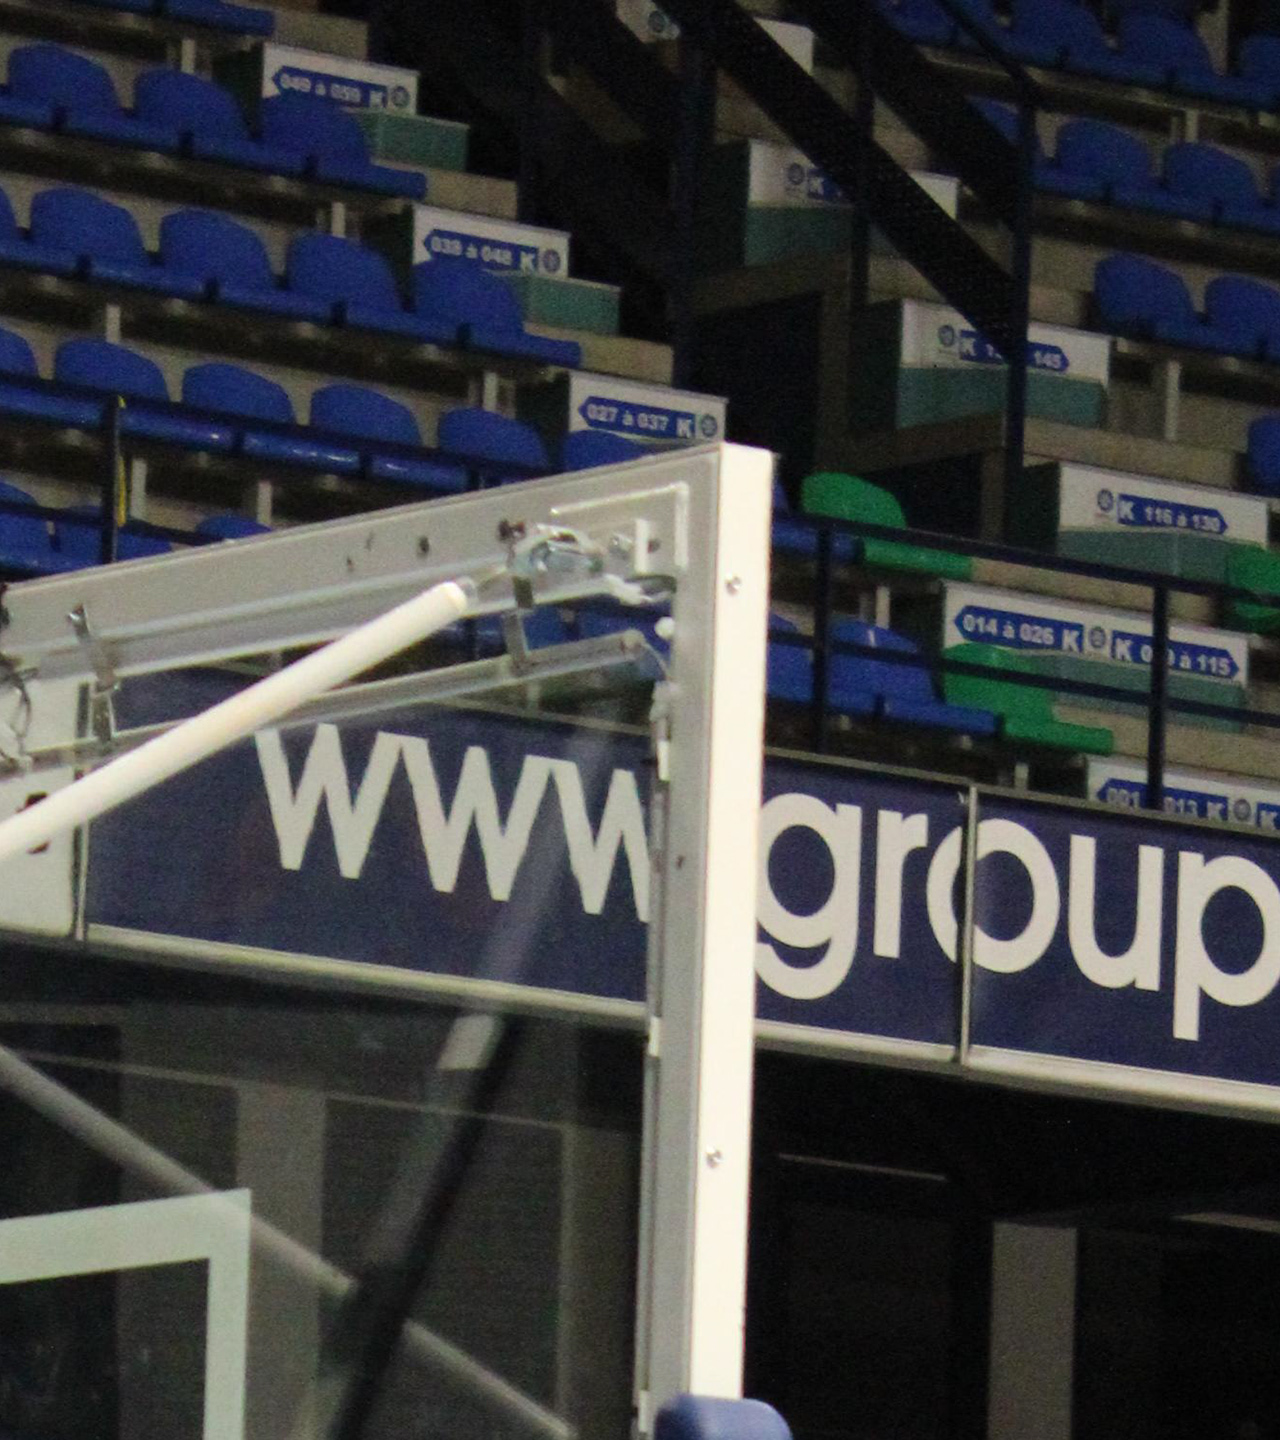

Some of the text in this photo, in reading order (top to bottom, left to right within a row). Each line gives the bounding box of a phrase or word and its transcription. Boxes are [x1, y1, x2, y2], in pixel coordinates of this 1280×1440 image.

[586, 404, 617, 423] 027
[637, 413, 668, 432] 037
[677, 418, 693, 438] K
[963, 614, 997, 633] 014
[1020, 624, 1054, 646] 026
[1062, 629, 1081, 653] K
[1116, 637, 1134, 662] K
[1197, 655, 1232, 676] 115
